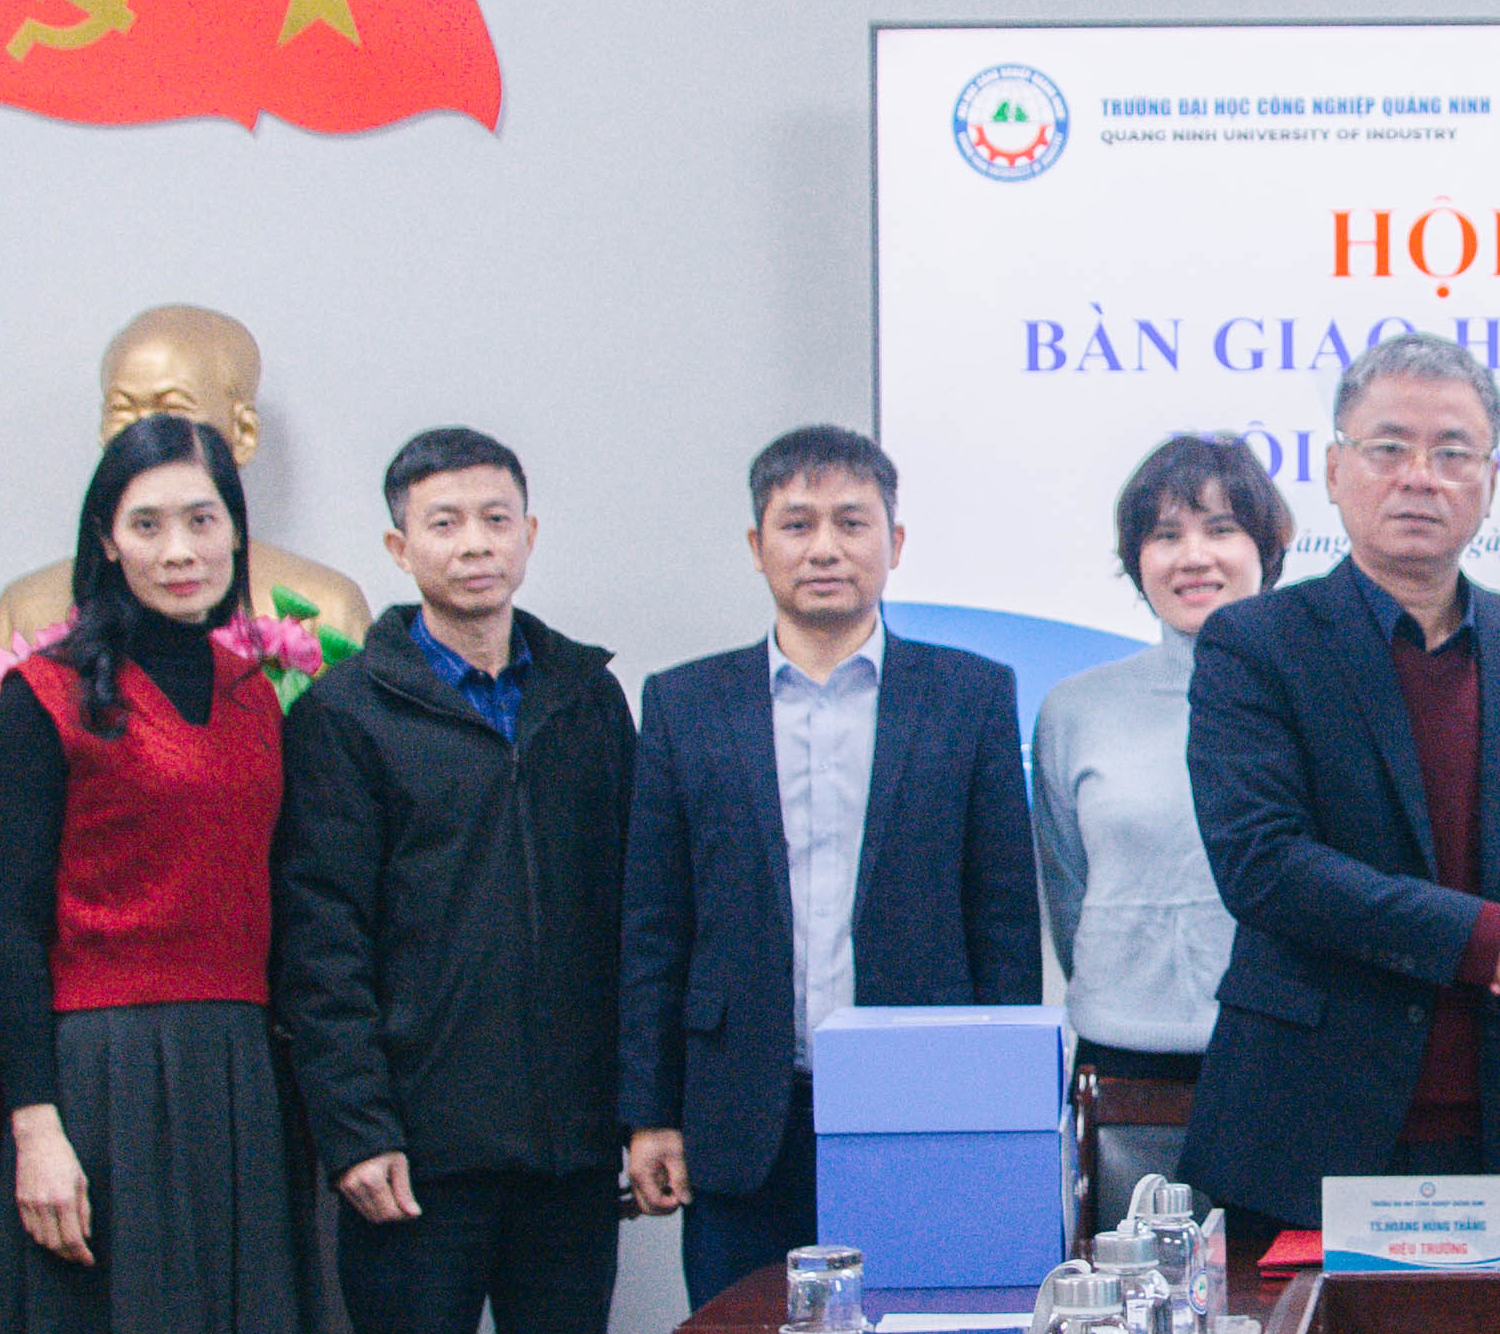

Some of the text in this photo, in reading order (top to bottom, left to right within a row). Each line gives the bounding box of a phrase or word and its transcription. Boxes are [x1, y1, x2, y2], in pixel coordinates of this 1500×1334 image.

[1449, 95, 1491, 115] NINH
[1100, 127, 1458, 145] QUANG NINH UNIVERSITY OF INDUSTRY
[1021, 301, 1183, 372] BÀN
